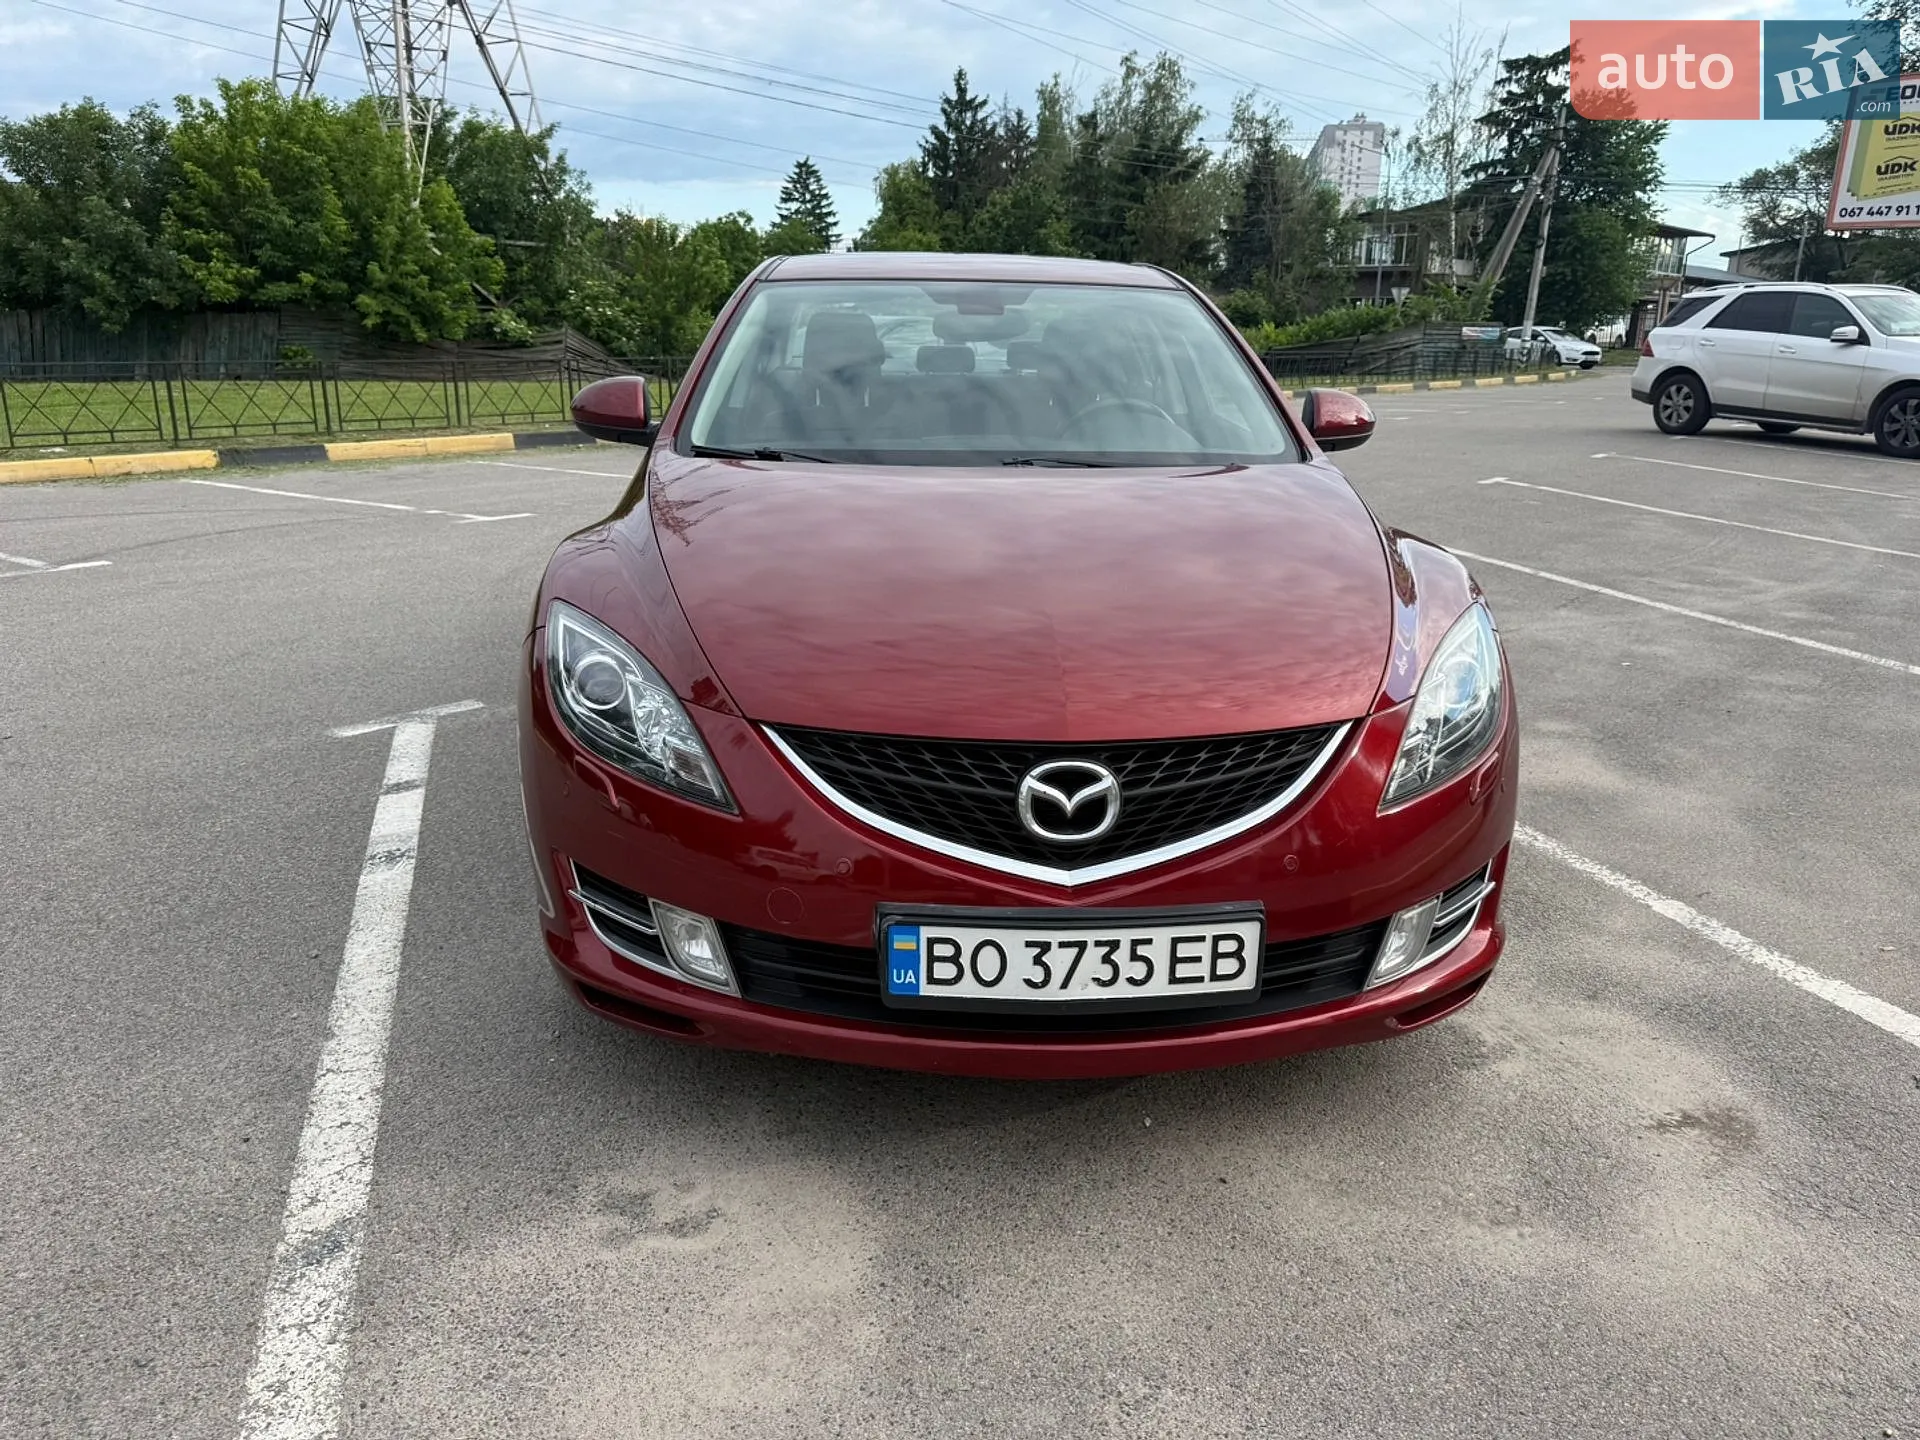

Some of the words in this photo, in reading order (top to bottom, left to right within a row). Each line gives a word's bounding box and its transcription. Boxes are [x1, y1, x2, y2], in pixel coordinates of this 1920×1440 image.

[1876, 160, 1919, 176] UDK
[1839, 206, 1864, 218] 067
[1866, 205, 1893, 217] 447
[1896, 204, 1911, 216] 91
[926, 936, 1008, 988] BO
[1022, 937, 1155, 990] 3735
[1167, 932, 1247, 986] EB
[893, 969, 917, 984] UA
